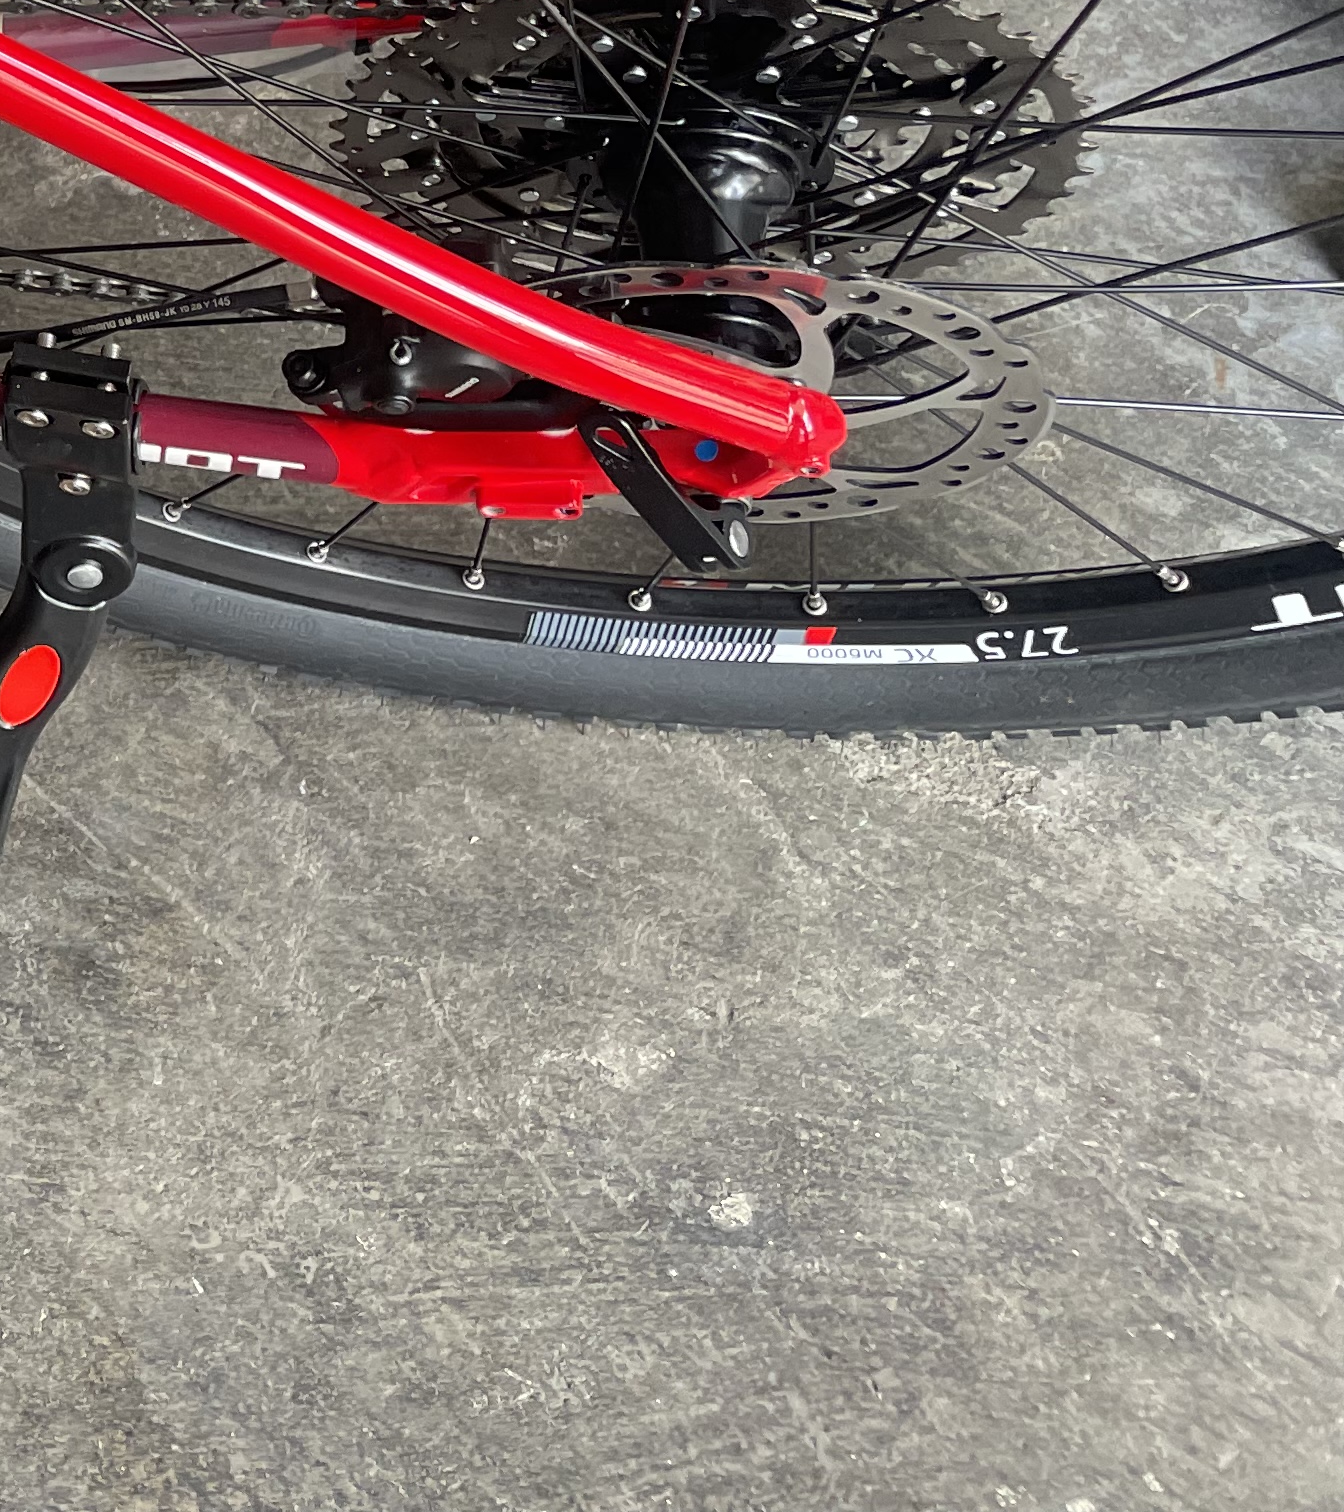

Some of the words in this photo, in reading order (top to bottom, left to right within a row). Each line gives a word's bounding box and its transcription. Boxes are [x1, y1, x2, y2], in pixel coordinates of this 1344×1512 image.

[975, 625, 1080, 661] 27.5
[806, 646, 883, 661] M6000
[897, 648, 938, 663] XC
